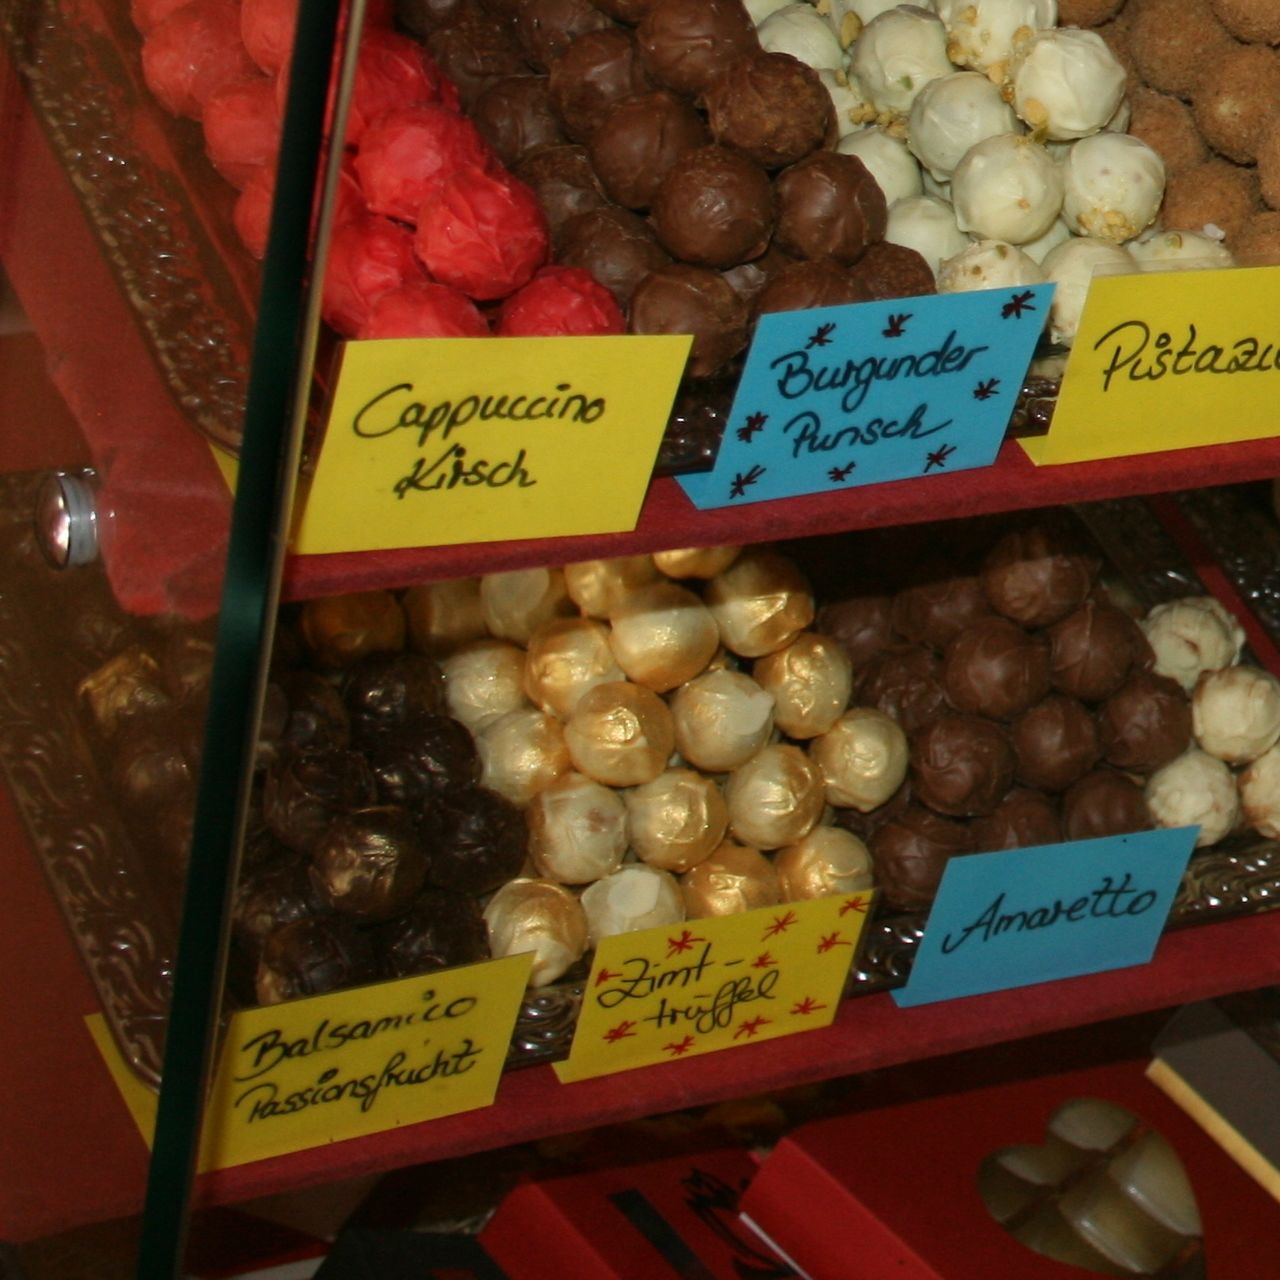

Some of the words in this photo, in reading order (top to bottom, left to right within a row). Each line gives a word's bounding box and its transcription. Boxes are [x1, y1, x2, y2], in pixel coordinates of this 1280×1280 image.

[770, 330, 990, 413] Burgunder
[353, 382, 606, 444] Cappuccino
[783, 403, 953, 458] Punsch
[393, 444, 537, 500] Kirsch
[940, 872, 1158, 955] Amaretto
[233, 989, 480, 1082] Balsamico
